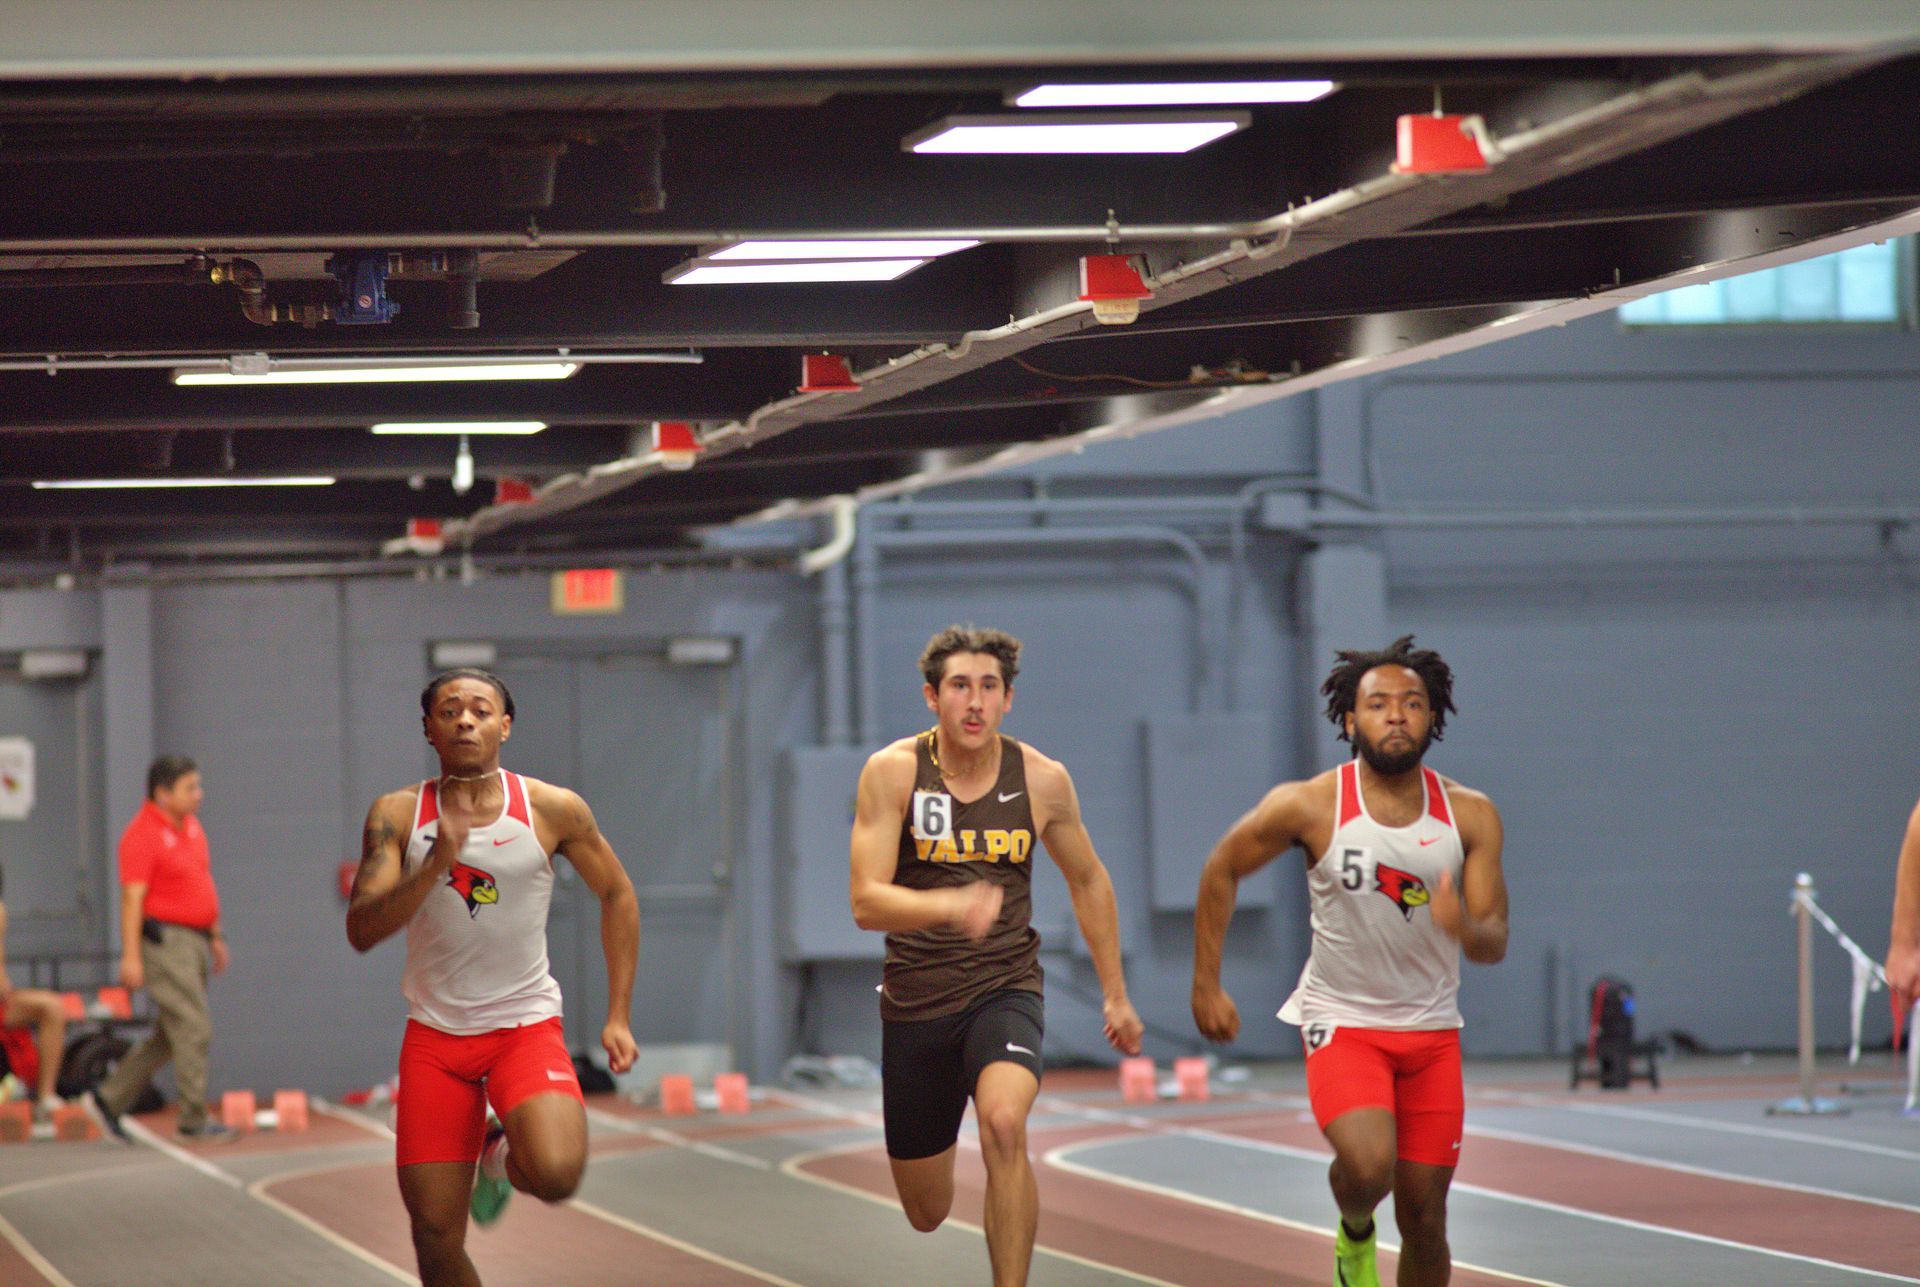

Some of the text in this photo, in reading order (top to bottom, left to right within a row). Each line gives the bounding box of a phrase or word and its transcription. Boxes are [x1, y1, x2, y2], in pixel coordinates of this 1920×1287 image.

[922, 796, 945, 836] 6
[910, 828, 1031, 864] VALPO
[1341, 848, 1363, 891] 5
